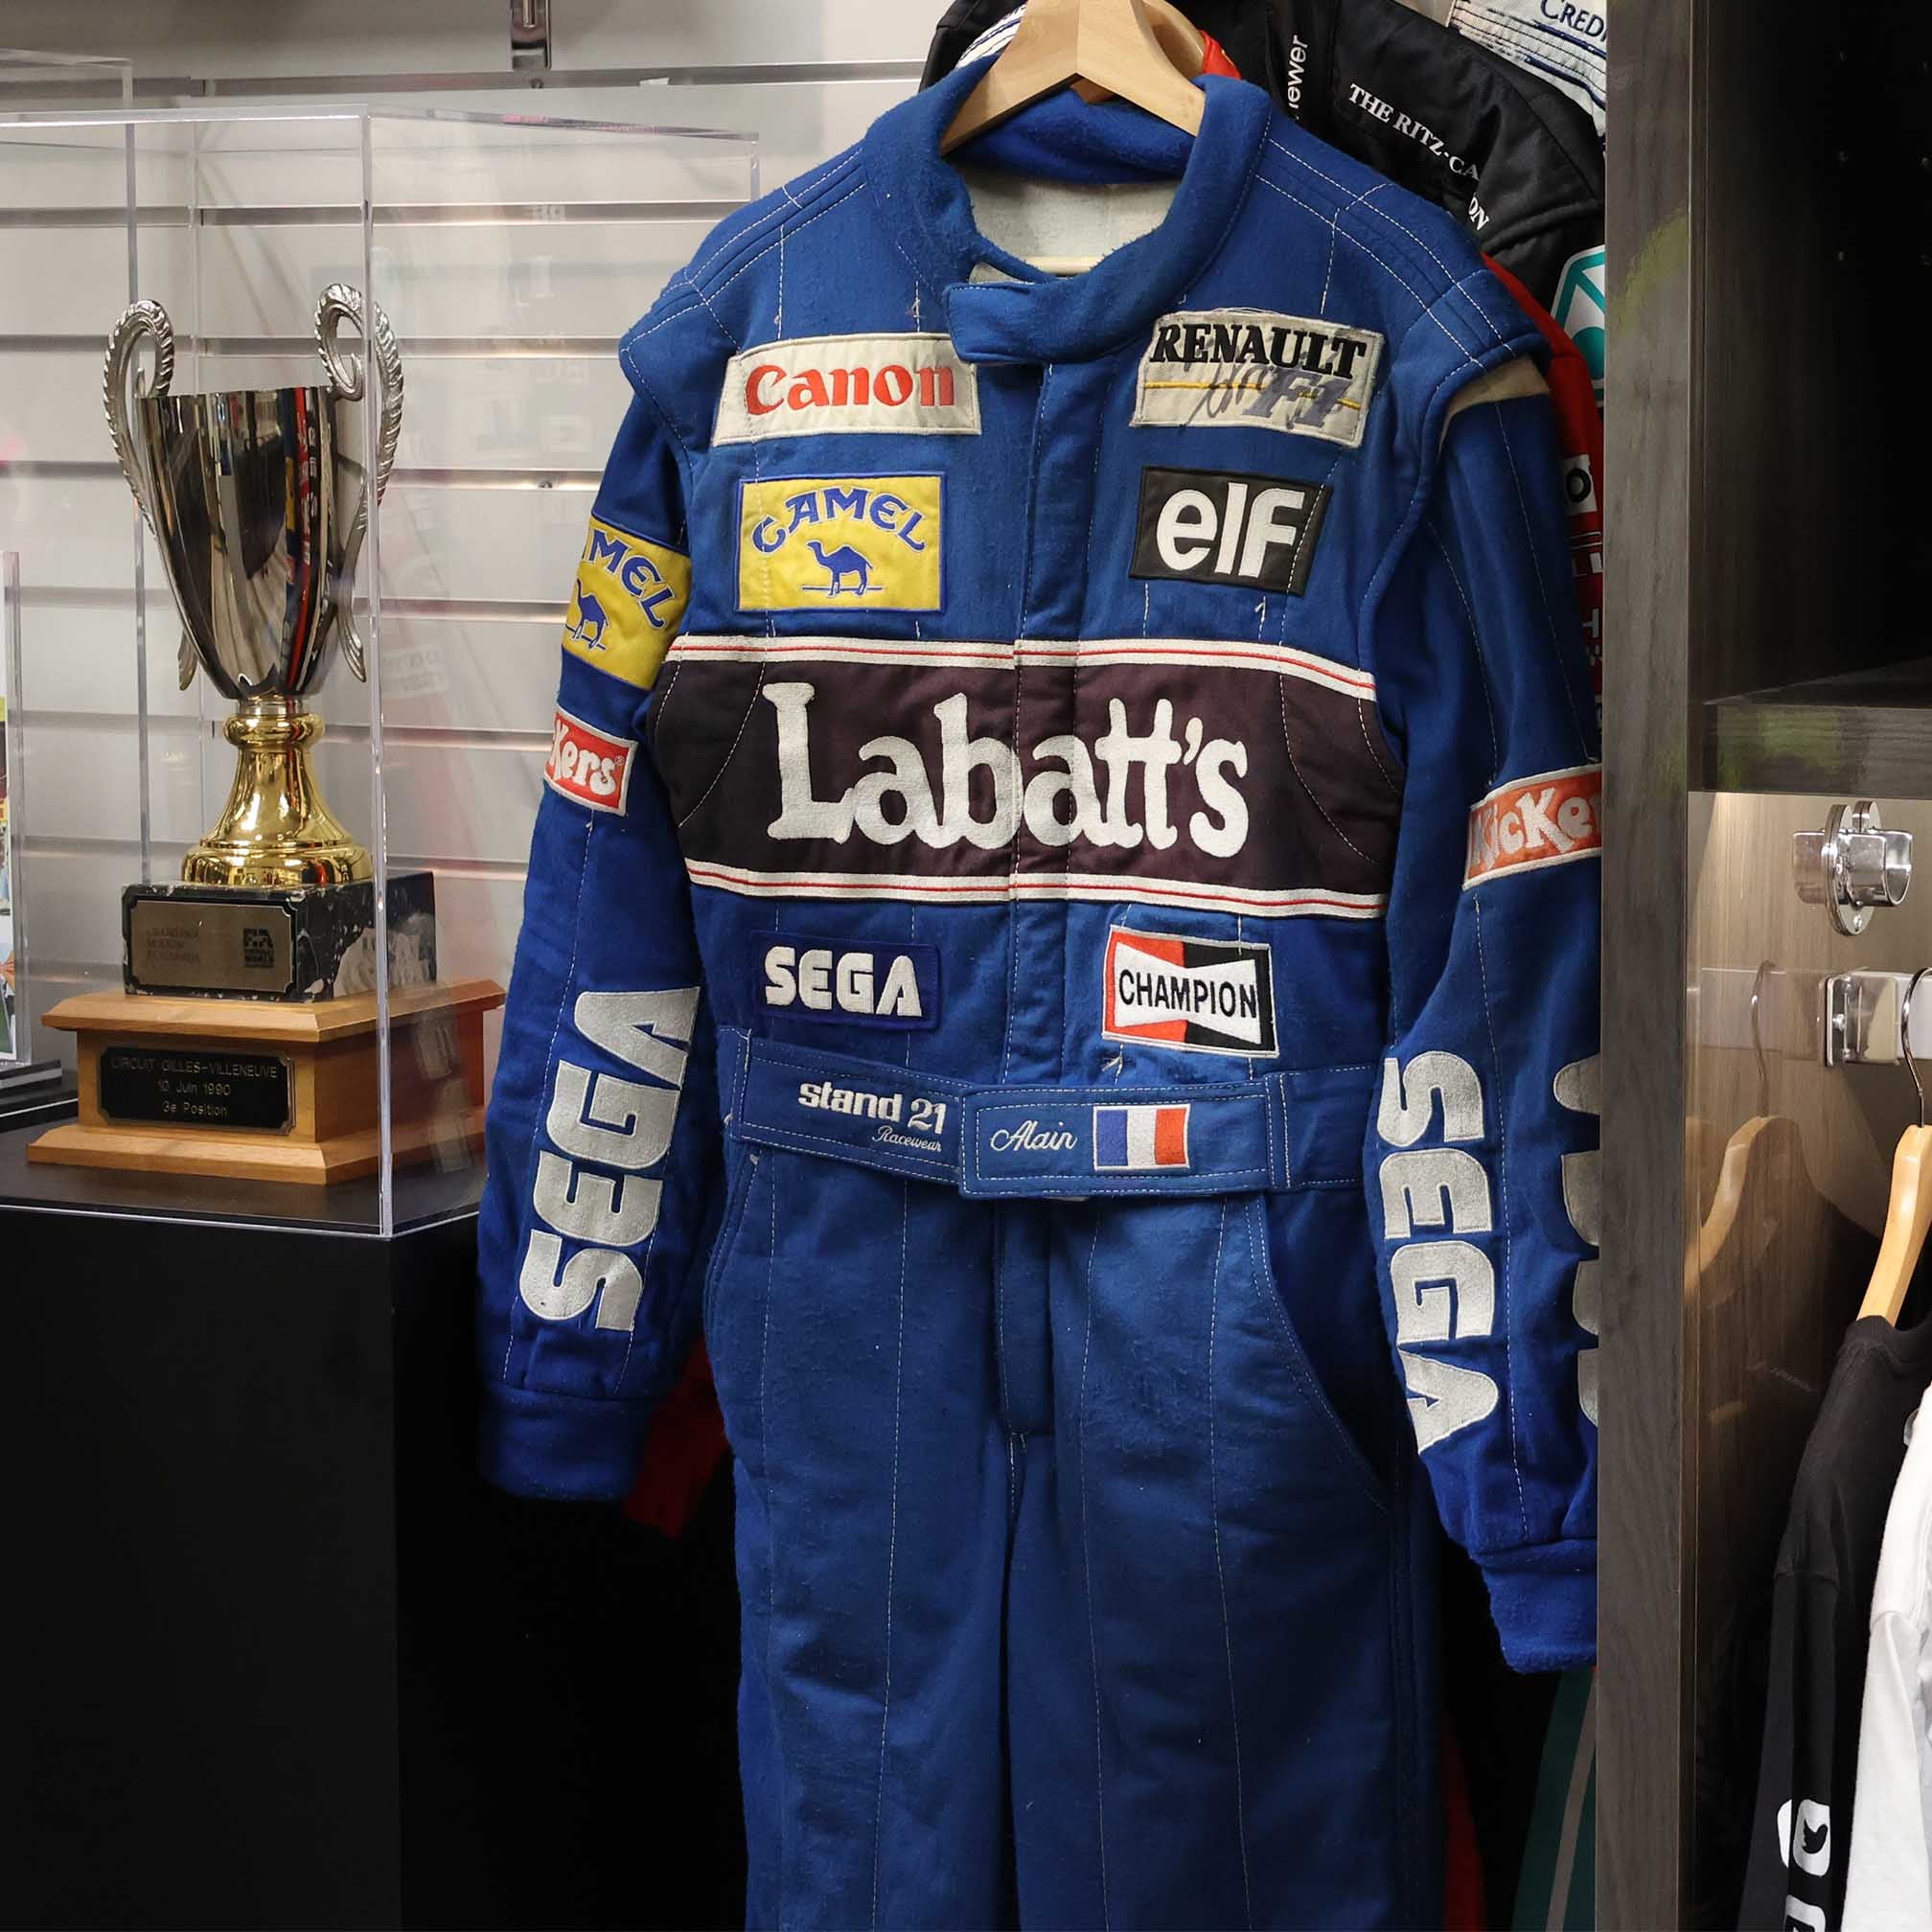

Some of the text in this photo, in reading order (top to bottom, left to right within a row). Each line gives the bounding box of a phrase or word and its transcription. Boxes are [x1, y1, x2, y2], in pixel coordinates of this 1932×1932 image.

[1540, 0, 1606, 42] CRED
[1348, 82, 1391, 124] THE
[1150, 323, 1367, 380] RENAULT
[745, 364, 955, 416] Canon
[751, 486, 927, 554] CAMEL
[1156, 482, 1305, 579] elf
[582, 527, 677, 630] MEL
[762, 681, 1250, 859] Labatt's
[765, 945, 923, 1018] SEGA
[1118, 968, 1257, 1019] CHAMPION
[183, 1101, 228, 1118] Position
[204, 1082, 231, 1096] 1990
[798, 1080, 947, 1136] stand 21
[518, 985, 702, 1332] SEGA
[871, 1125, 943, 1153] Racewear
[990, 1120, 1078, 1152] Alain
[1376, 1050, 1499, 1456] SEGA
